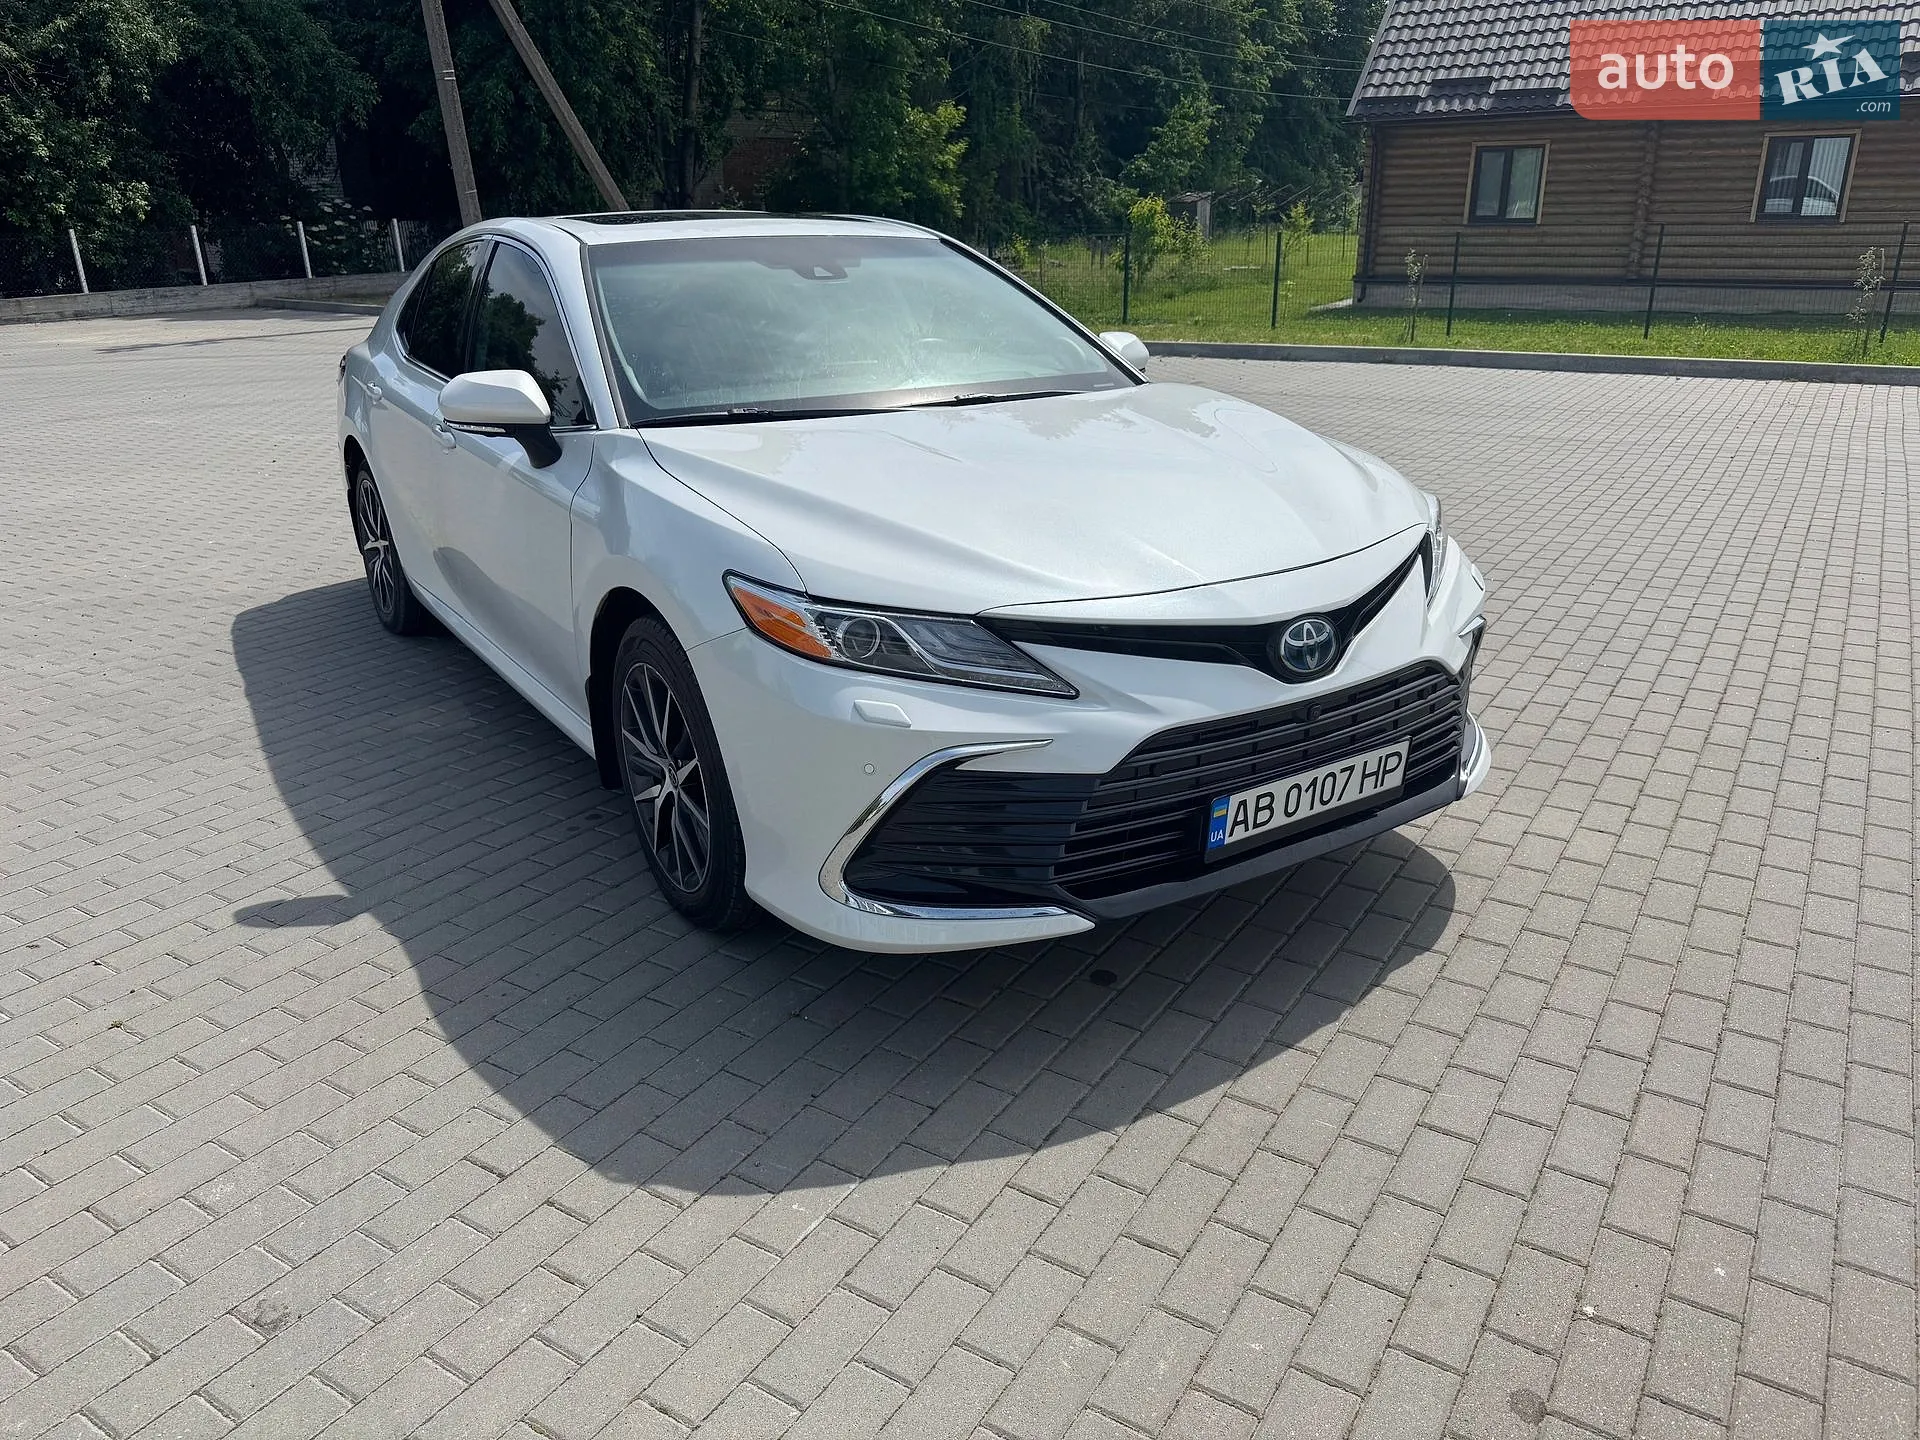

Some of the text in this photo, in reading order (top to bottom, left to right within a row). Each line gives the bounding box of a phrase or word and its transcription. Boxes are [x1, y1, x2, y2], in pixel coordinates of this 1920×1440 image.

[1228, 751, 1403, 838] AB 0107 HP
[1210, 829, 1224, 842] UA
